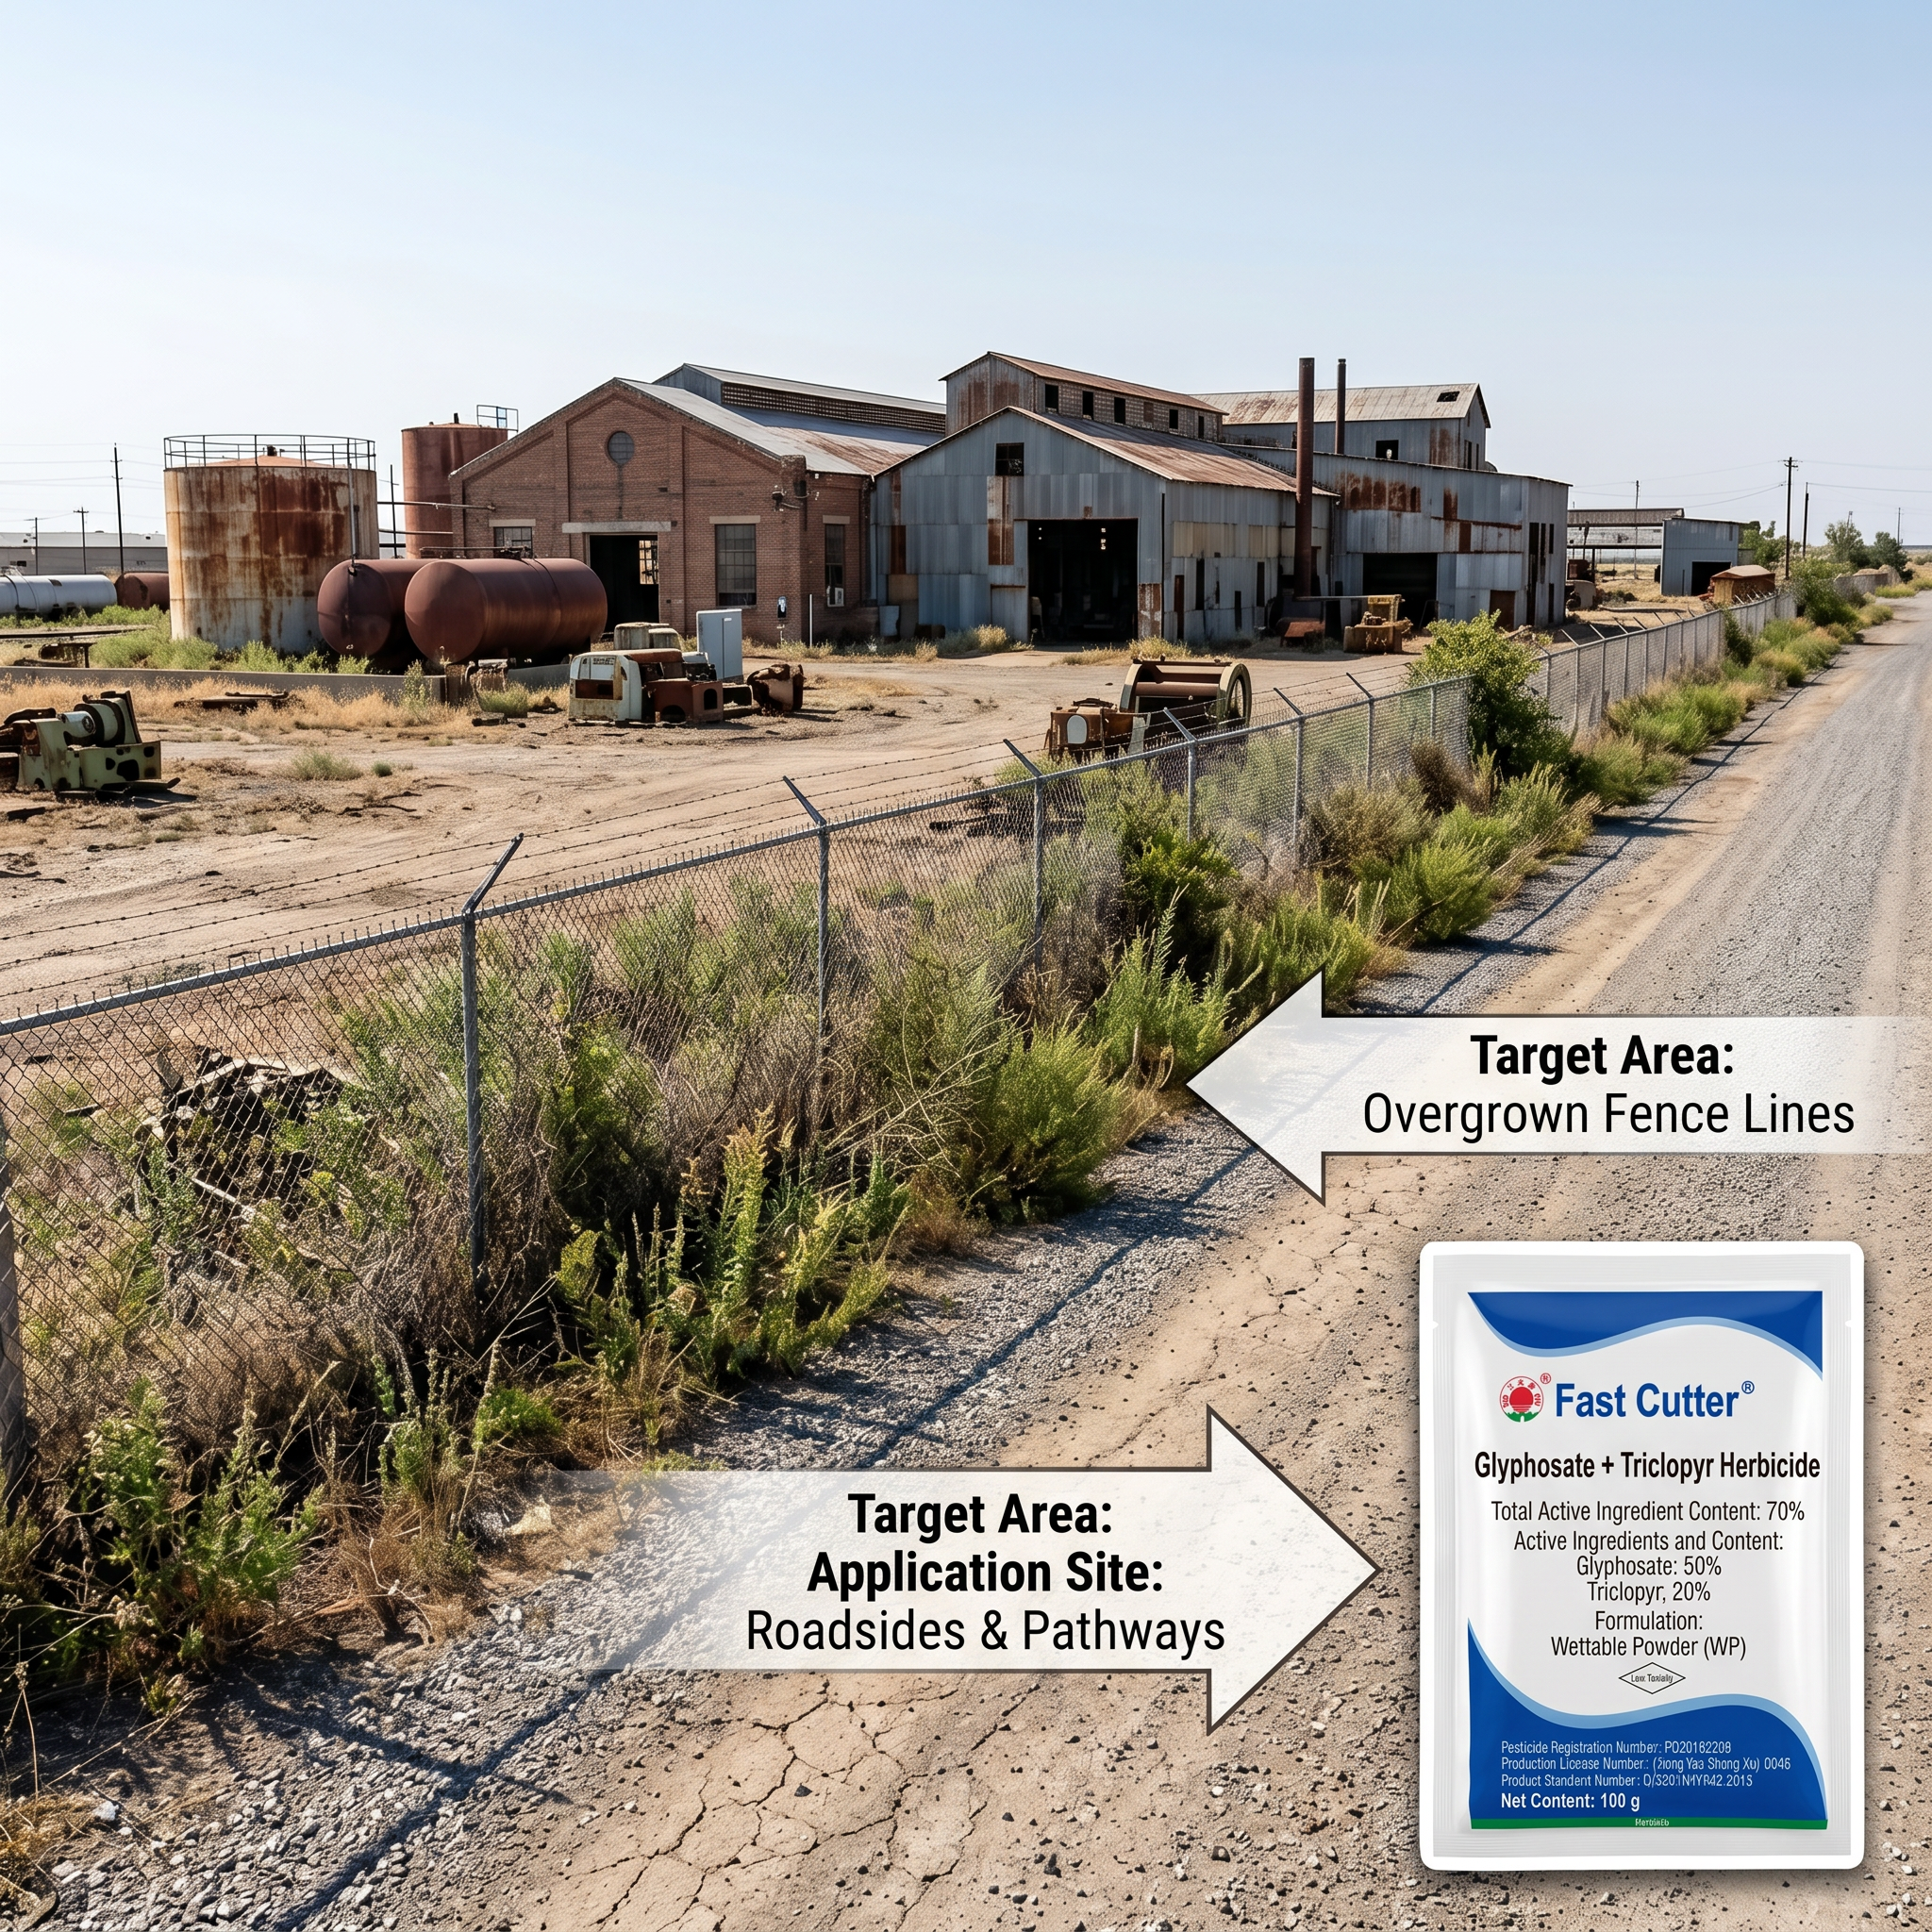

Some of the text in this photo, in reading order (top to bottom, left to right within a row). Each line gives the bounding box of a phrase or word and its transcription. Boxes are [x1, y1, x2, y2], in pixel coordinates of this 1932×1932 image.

[1556, 1383, 1626, 1417] Fast
[1474, 1451, 1821, 1484] Glyphosate + Triclopyr Herbicide
[1491, 1500, 1805, 1526] Total Active Ingredient Content: 70%
[1513, 1529, 1783, 1557] Active Ingredients and Content:
[1576, 1555, 1722, 1580] Glyphosate: 50%
[1586, 1580, 1711, 1606] Triclopyr, 20%
[1595, 1610, 1703, 1631] Formulation:
[1551, 1636, 1746, 1660] Wettable Powder (WP)
[1501, 1740, 1549, 1754] Pesticide
[1551, 1740, 1613, 1757] Registration
[1501, 1757, 1557, 1770] Production
[1501, 1774, 1541, 1787] Product
[1501, 1792, 1641, 1812] Net Content: 100 g
